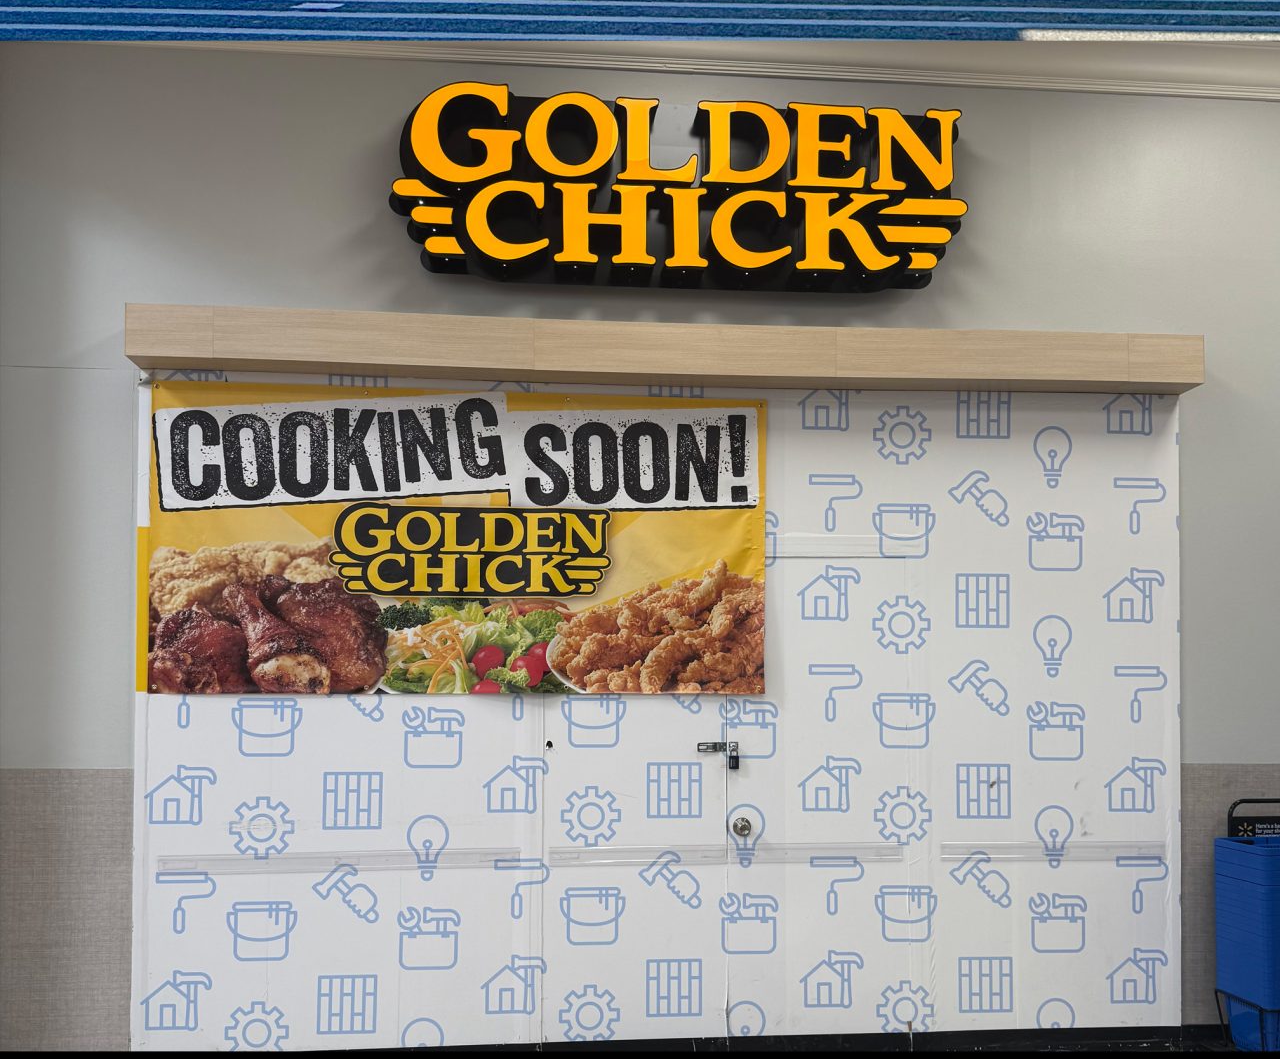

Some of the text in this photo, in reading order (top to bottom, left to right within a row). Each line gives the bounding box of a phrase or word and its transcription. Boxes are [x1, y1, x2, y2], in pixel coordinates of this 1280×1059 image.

[410, 81, 962, 191] GOLDEN
[465, 180, 900, 271] CHICK
[169, 397, 748, 507] COOKING SOON!
[339, 508, 607, 557] GOLDEN
[368, 553, 572, 595] CHICK
